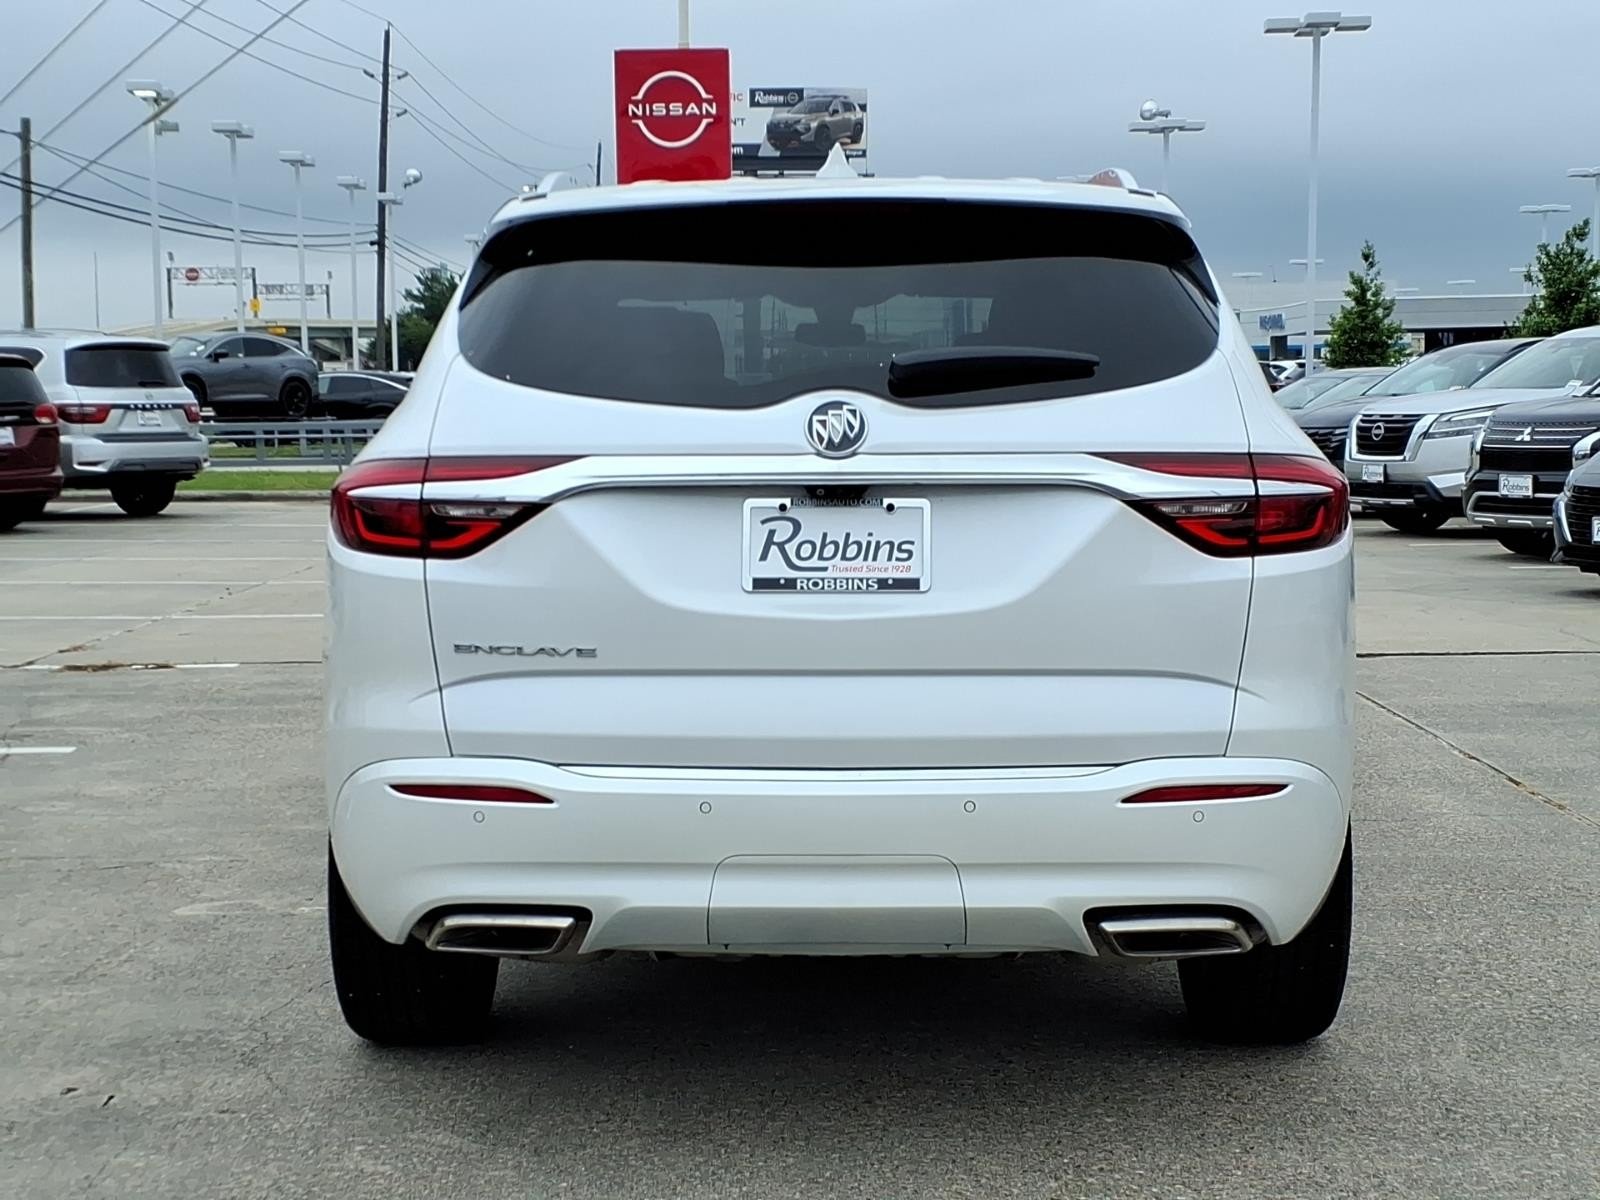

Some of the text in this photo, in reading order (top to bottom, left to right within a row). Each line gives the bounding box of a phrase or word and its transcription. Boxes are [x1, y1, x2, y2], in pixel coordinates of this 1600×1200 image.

[731, 93, 744, 102] IC
[628, 102, 717, 117] NISSAN
[1502, 478, 1530, 493] Robbins
[792, 497, 881, 507] ROBBINSAUTO.COM
[758, 515, 916, 573] Robbins
[831, 564, 912, 573] Trusted Since 1928
[796, 578, 879, 590] ROBBINS
[453, 643, 598, 658] ENCLAVE
